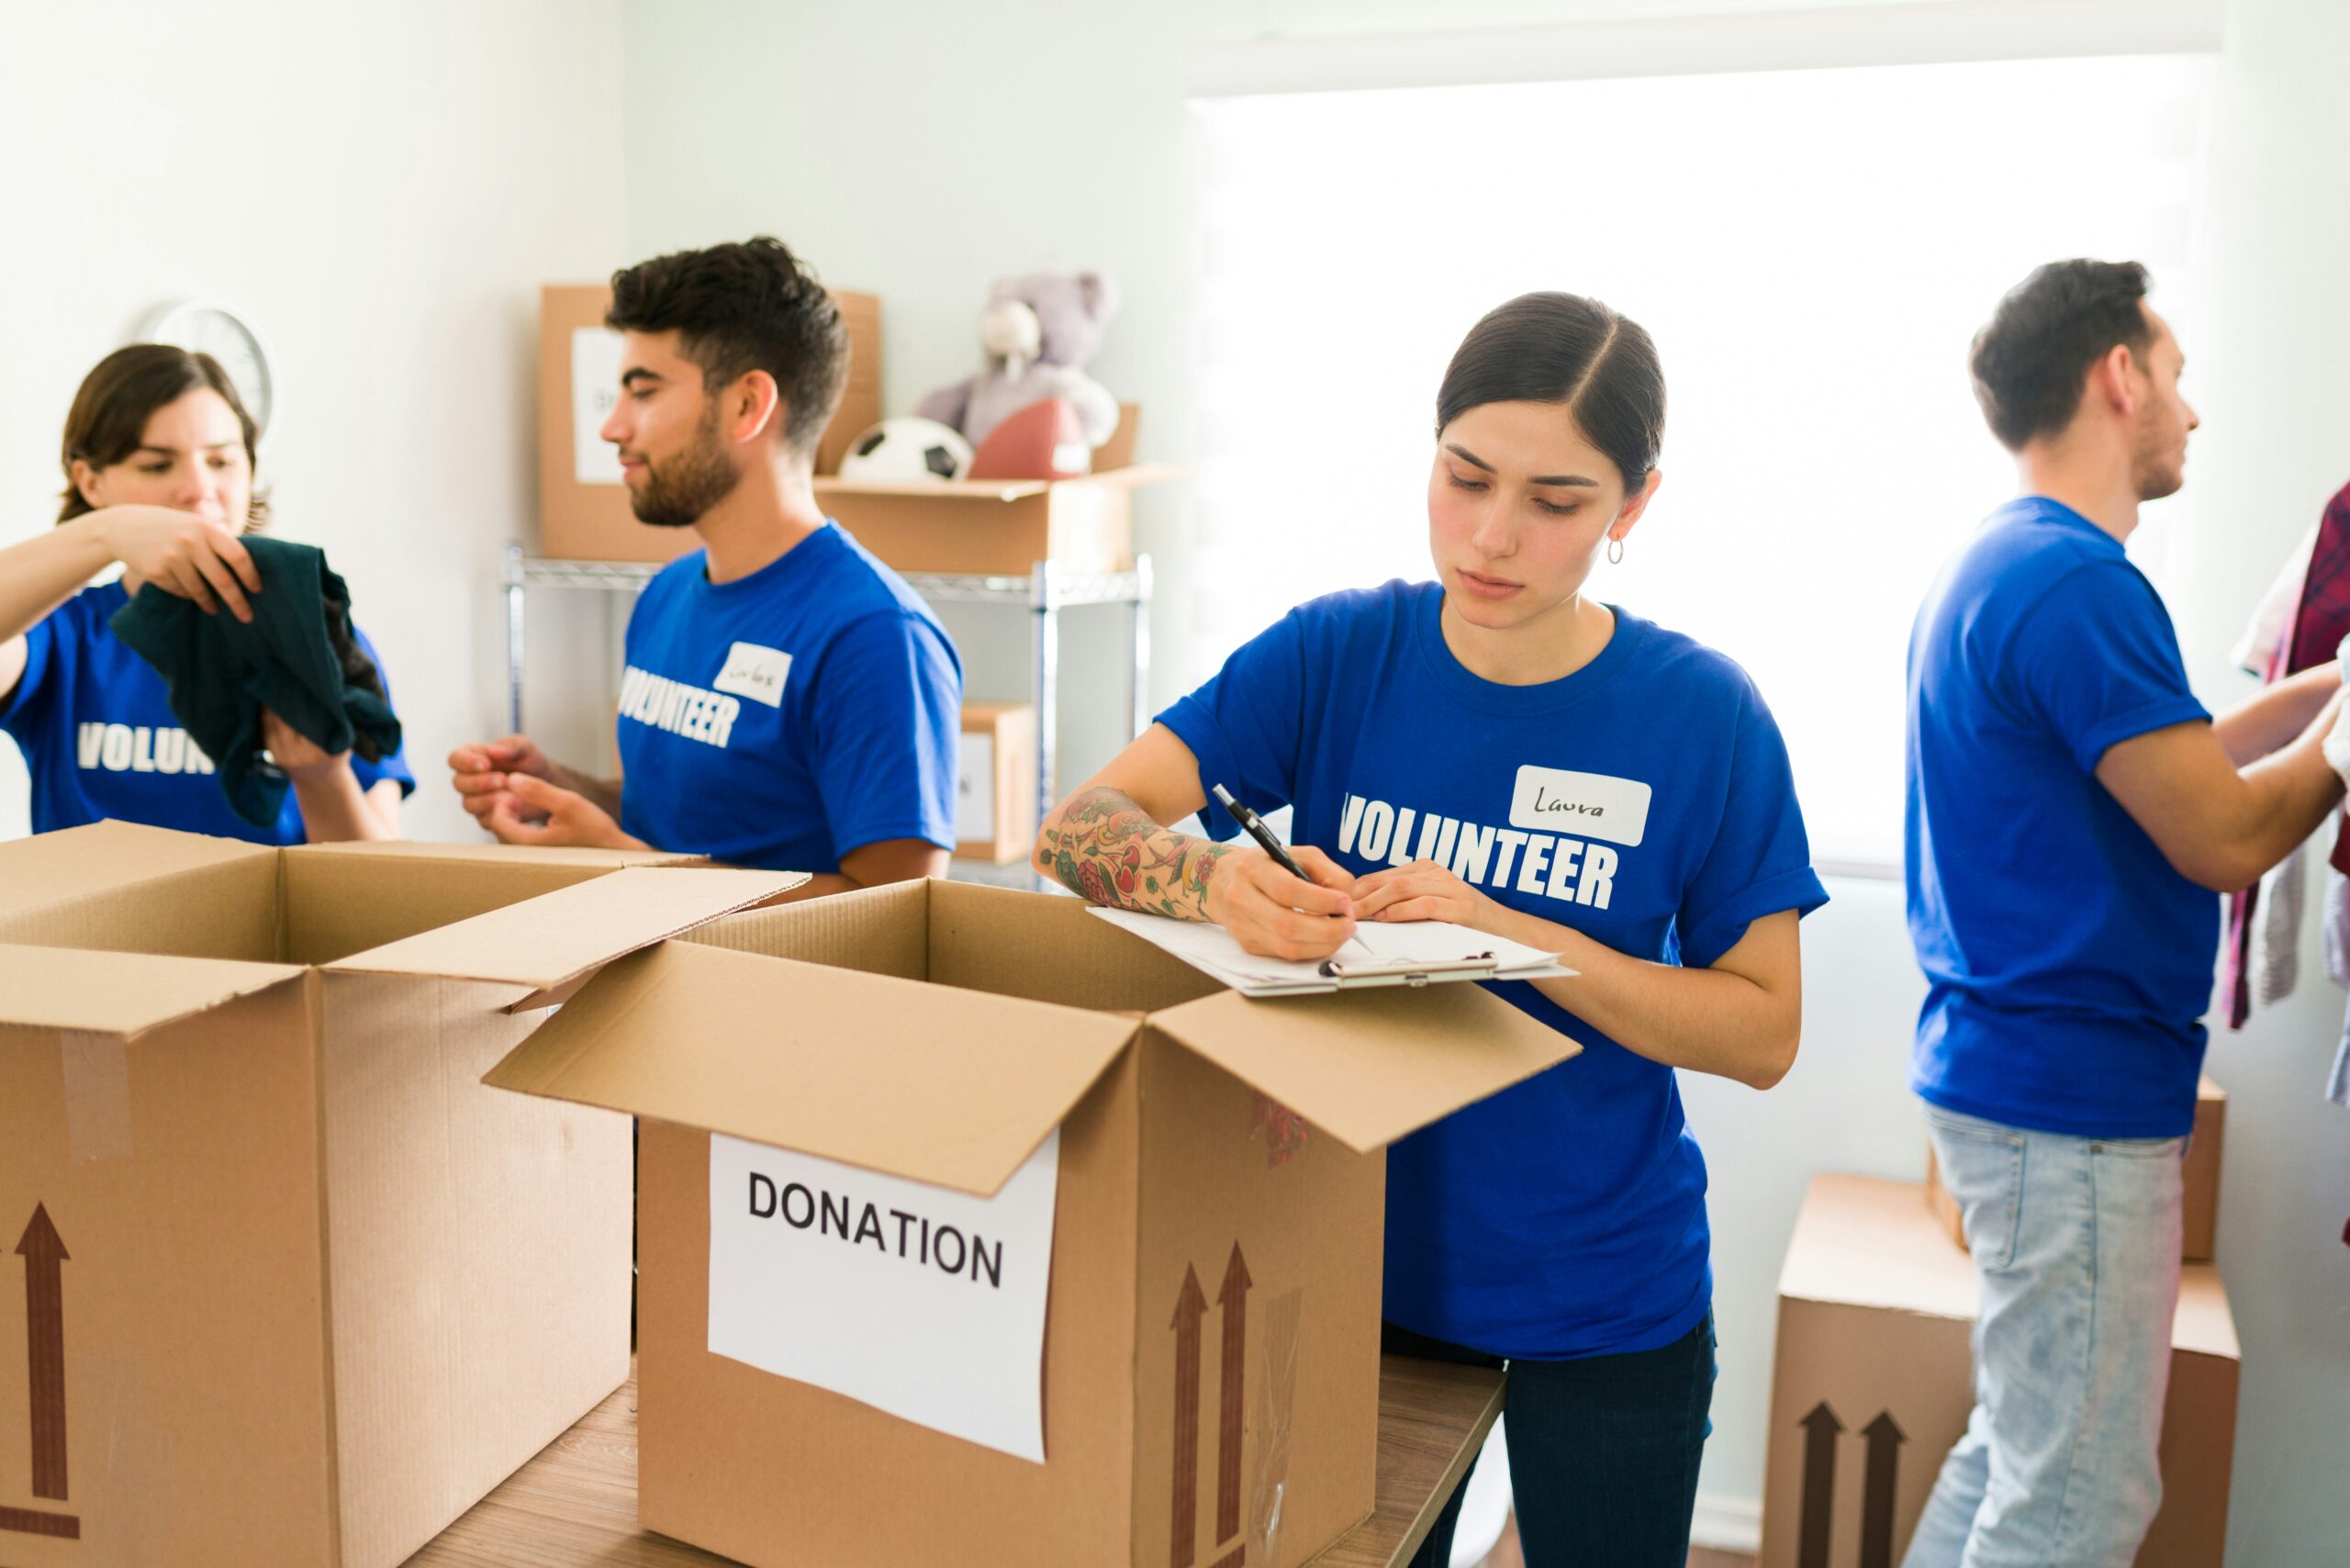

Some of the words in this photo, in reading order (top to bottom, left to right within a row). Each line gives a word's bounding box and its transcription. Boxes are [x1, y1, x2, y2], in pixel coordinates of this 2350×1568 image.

[1337, 791, 1619, 911] VOLUNTEER
[1533, 786, 1605, 818] Laura
[749, 1170, 1002, 1289] DONATION
